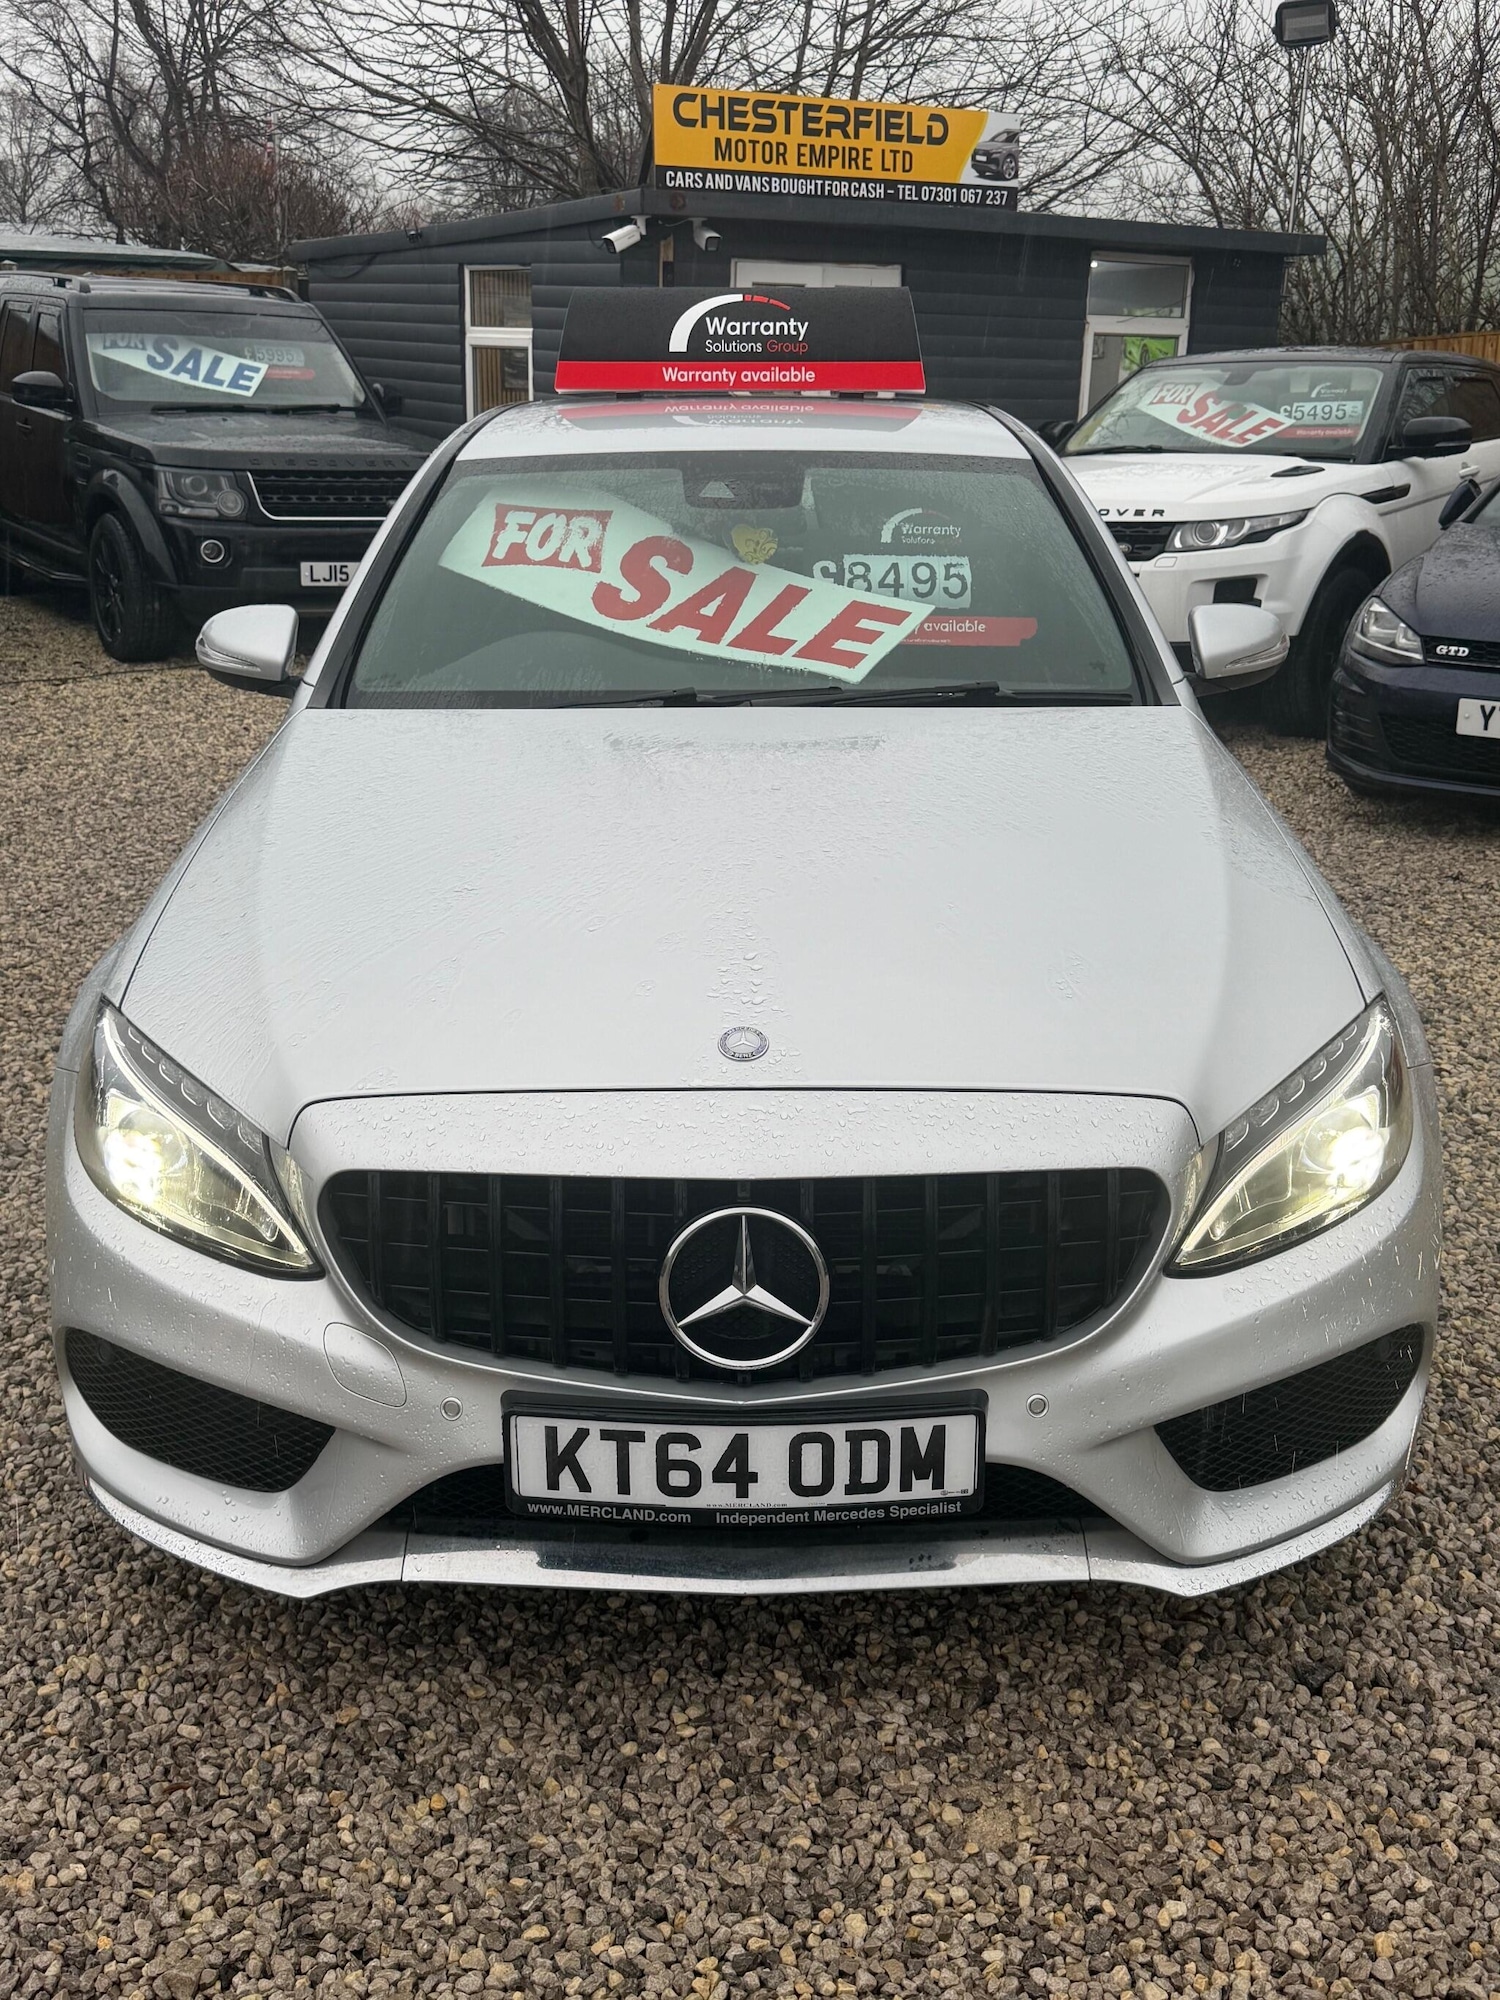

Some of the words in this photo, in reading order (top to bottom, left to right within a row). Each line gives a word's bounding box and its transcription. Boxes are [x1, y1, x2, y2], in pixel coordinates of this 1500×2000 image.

[673, 92, 949, 146] CHESTERFIELD
[714, 137, 788, 166] MOTOR
[797, 143, 873, 170] EMPIRE
[881, 148, 913, 173] LTD
[665, 170, 703, 188] CARS
[705, 172, 733, 190] AND
[735, 174, 770, 193] VANS
[771, 177, 823, 195] BOUGHT
[824, 180, 849, 197] FOR
[850, 182, 884, 199] CASH
[897, 184, 919, 201] TEL
[921, 186, 957, 202] 07301
[960, 187, 982, 204] 067
[986, 190, 1008, 206] 237
[705, 317, 809, 341] Warranty
[705, 339, 762, 353] Solutions
[766, 339, 809, 356] Group
[147, 335, 262, 392] SALE
[662, 366, 736, 387] Warranty
[741, 366, 816, 383] available
[1152, 383, 1197, 404] FOR
[1177, 390, 1285, 445] SALE
[1280, 403, 1347, 421] £5495
[1098, 508, 1165, 517] OVER
[492, 509, 602, 565] FOR
[309, 565, 349, 583] LJ15
[591, 535, 912, 670] SALE
[923, 620, 986, 633] available
[1435, 644, 1469, 657] GTD
[1480, 704, 1500, 731] Y
[543, 1425, 759, 1499] KT64
[788, 1424, 947, 1498] ODM
[527, 1503, 691, 1524] www.MERCLAND.com
[716, 1509, 810, 1526] Independent
[813, 1506, 885, 1523] Mercedes
[889, 1501, 962, 1519] Specialist
